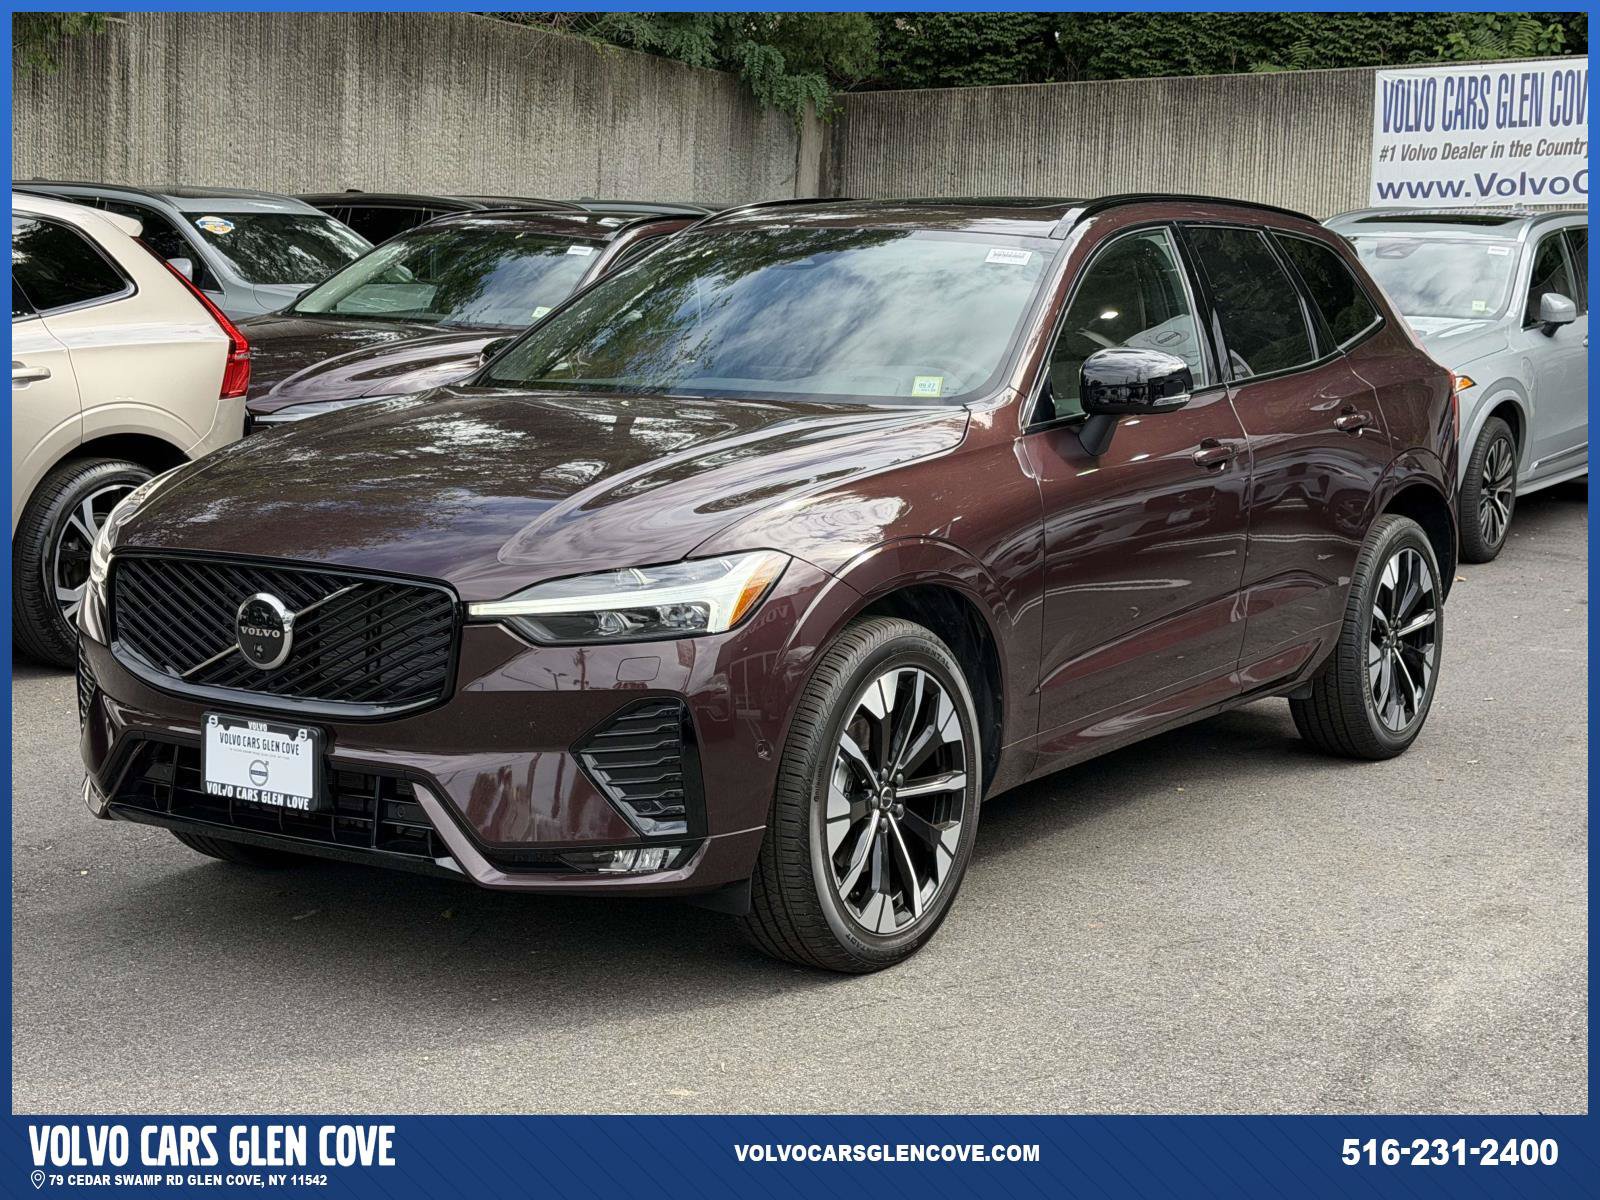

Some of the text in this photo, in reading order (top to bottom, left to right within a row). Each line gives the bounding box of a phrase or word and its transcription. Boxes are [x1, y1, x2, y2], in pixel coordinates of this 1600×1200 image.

[1382, 69, 1589, 133] VOLVO CARS GLEN COV
[1379, 144, 1397, 162] #1
[1401, 143, 1438, 161] Volvo
[1441, 142, 1488, 160] Dealer
[1490, 140, 1505, 158] in
[1509, 139, 1532, 158] the
[241, 626, 280, 638] VOLVO
[248, 720, 268, 732] VOLVO
[219, 732, 241, 746] VOLVO
[242, 735, 260, 750] CARS
[262, 738, 280, 753] GLEN
[281, 742, 300, 756] COVE
[206, 781, 233, 798] VOLVO
[236, 786, 259, 802] CARS
[261, 790, 284, 807] GLEN
